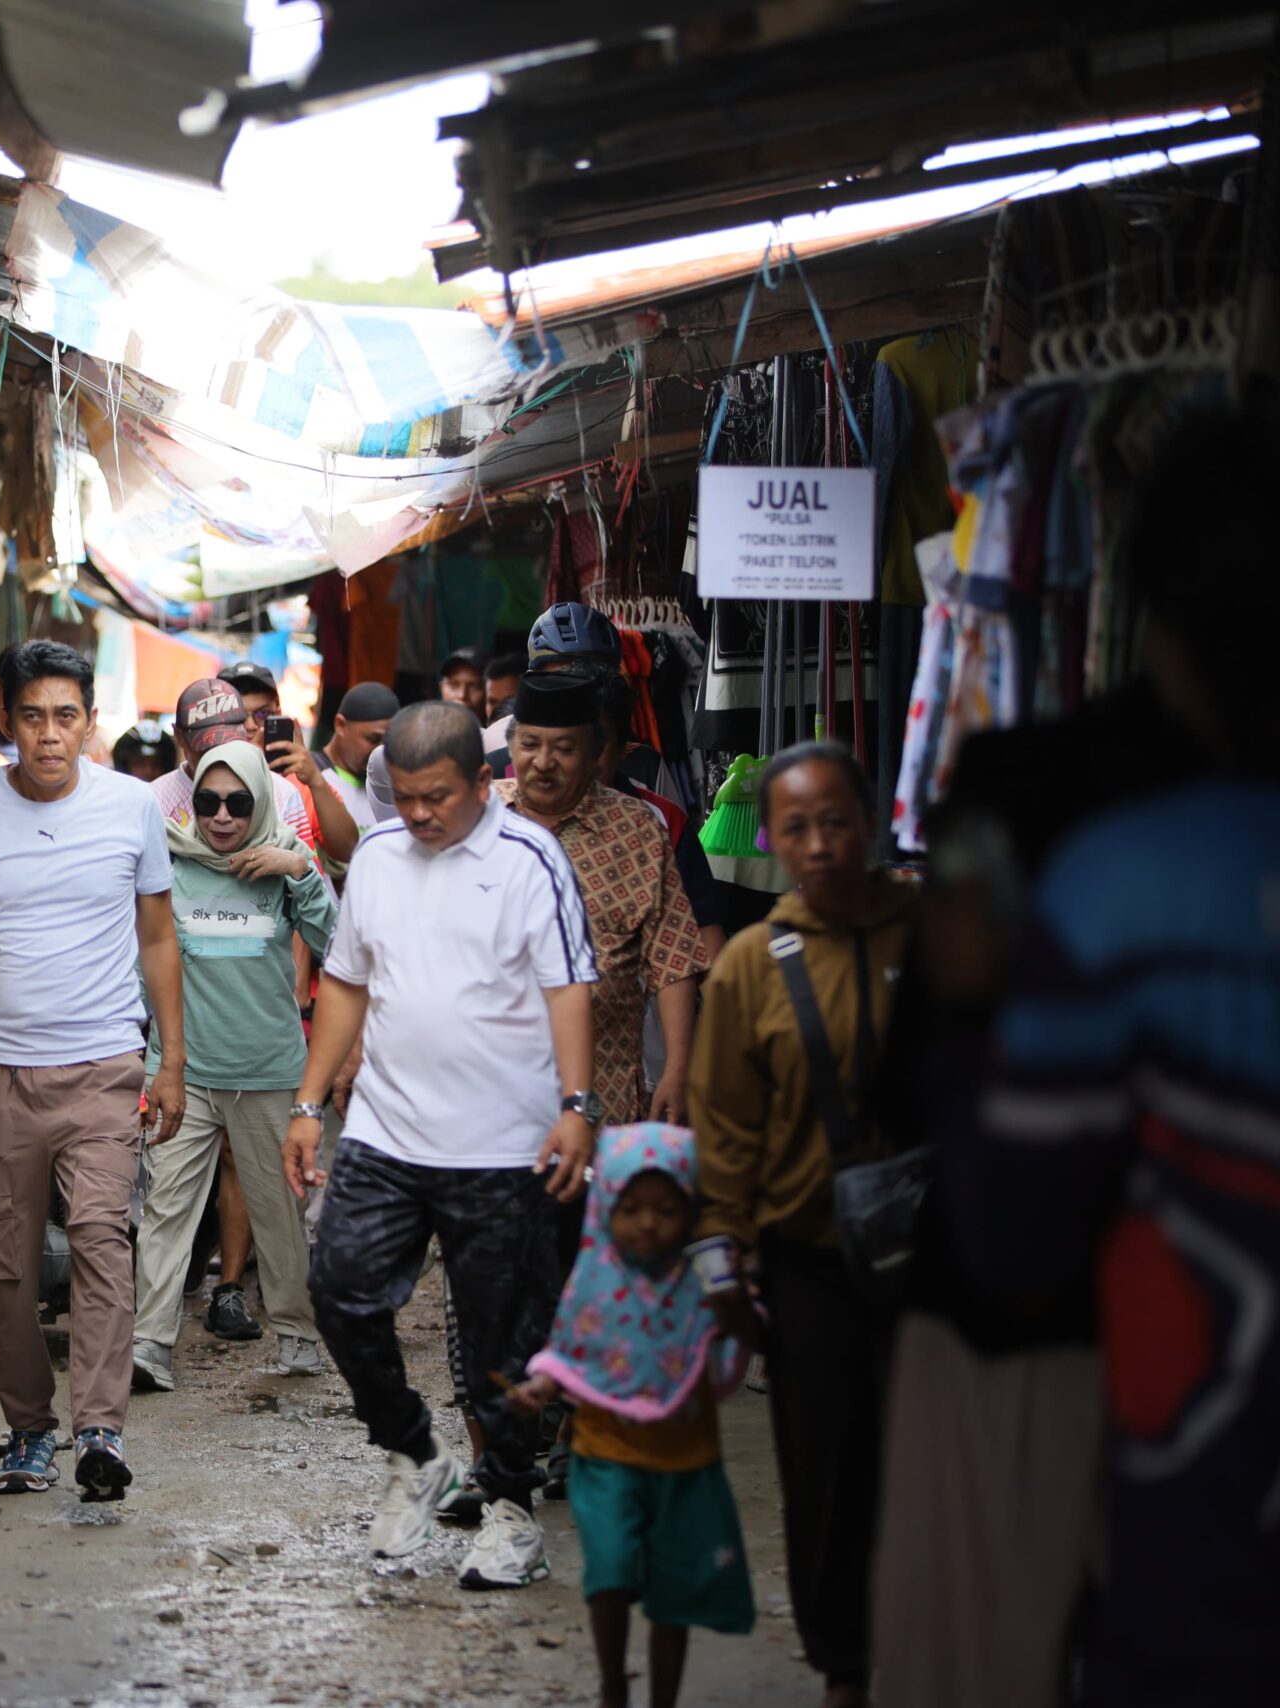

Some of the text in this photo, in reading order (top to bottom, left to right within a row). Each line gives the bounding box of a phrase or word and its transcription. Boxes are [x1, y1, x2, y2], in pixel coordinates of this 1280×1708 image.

[747, 480, 829, 511] JUAL
[789, 533, 837, 547] LISTRIK
[788, 555, 837, 569] TELFON
[187, 692, 239, 725] KTM
[192, 908, 249, 926] Six Diary
